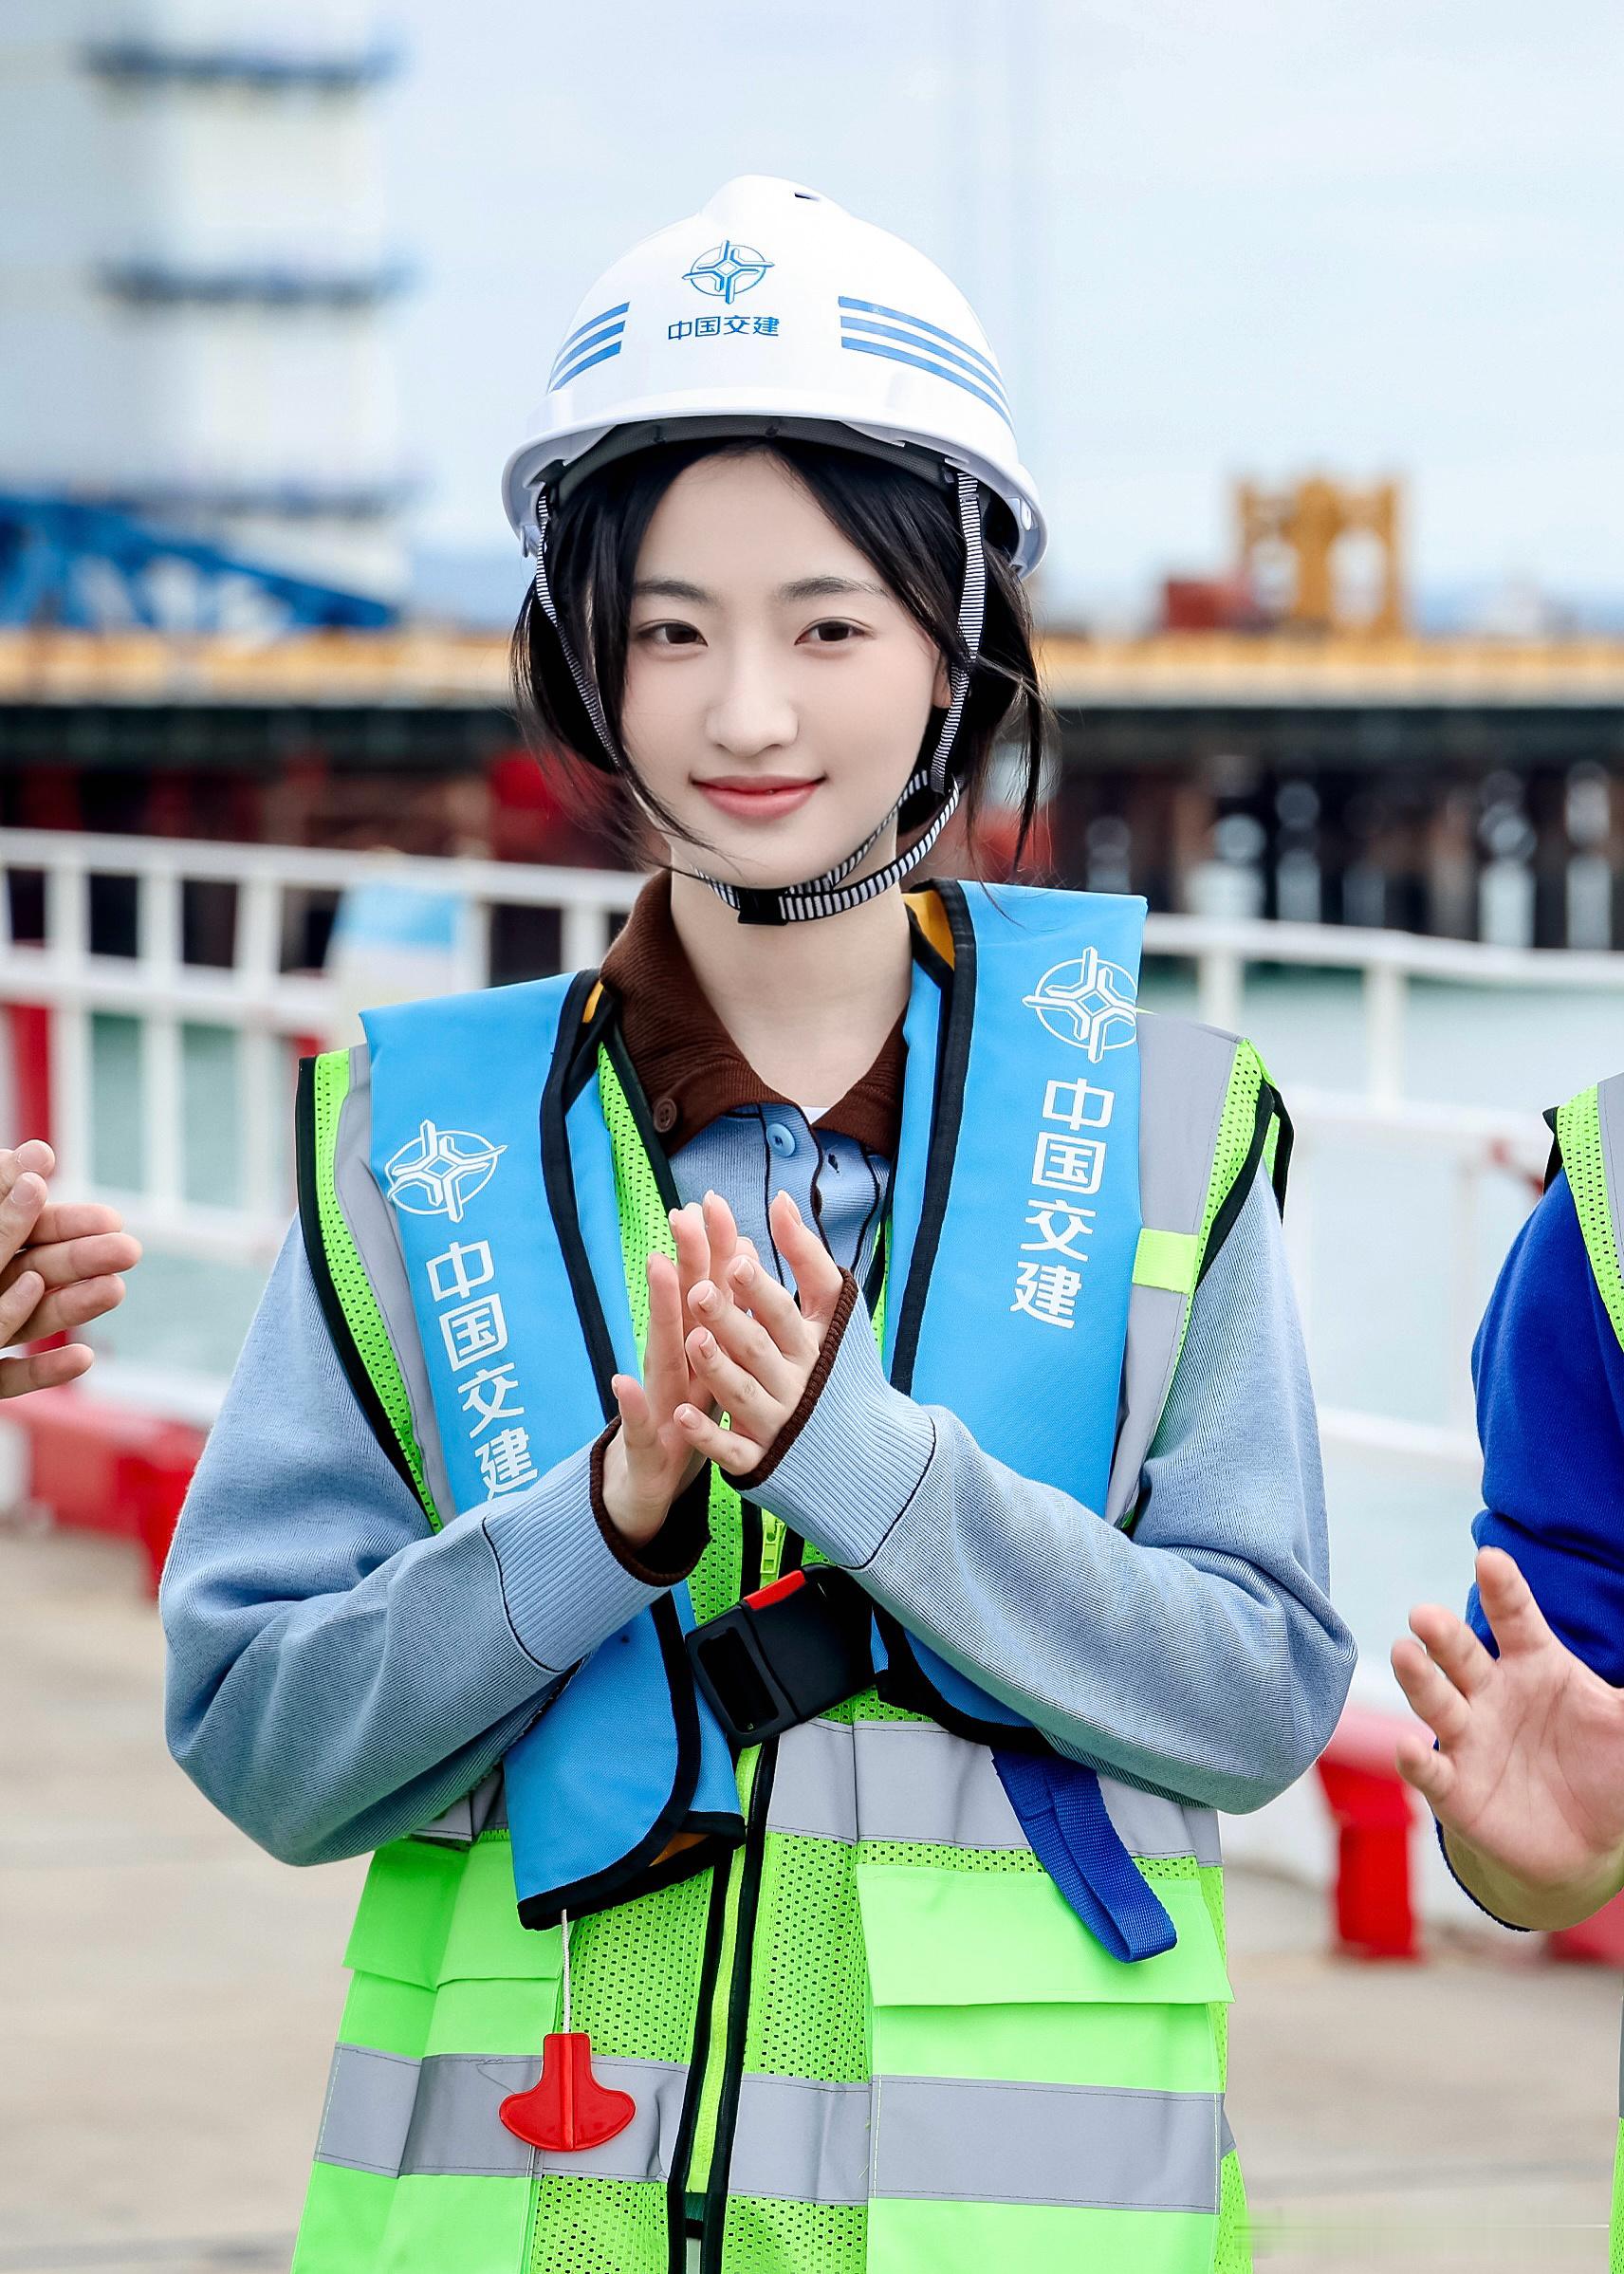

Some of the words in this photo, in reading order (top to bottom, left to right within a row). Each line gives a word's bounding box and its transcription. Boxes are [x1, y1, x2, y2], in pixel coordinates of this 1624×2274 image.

[667, 315, 780, 341] 中国交建
[1009, 1077, 1116, 1330] 中国交建
[425, 1239, 539, 1501] 中国交建
